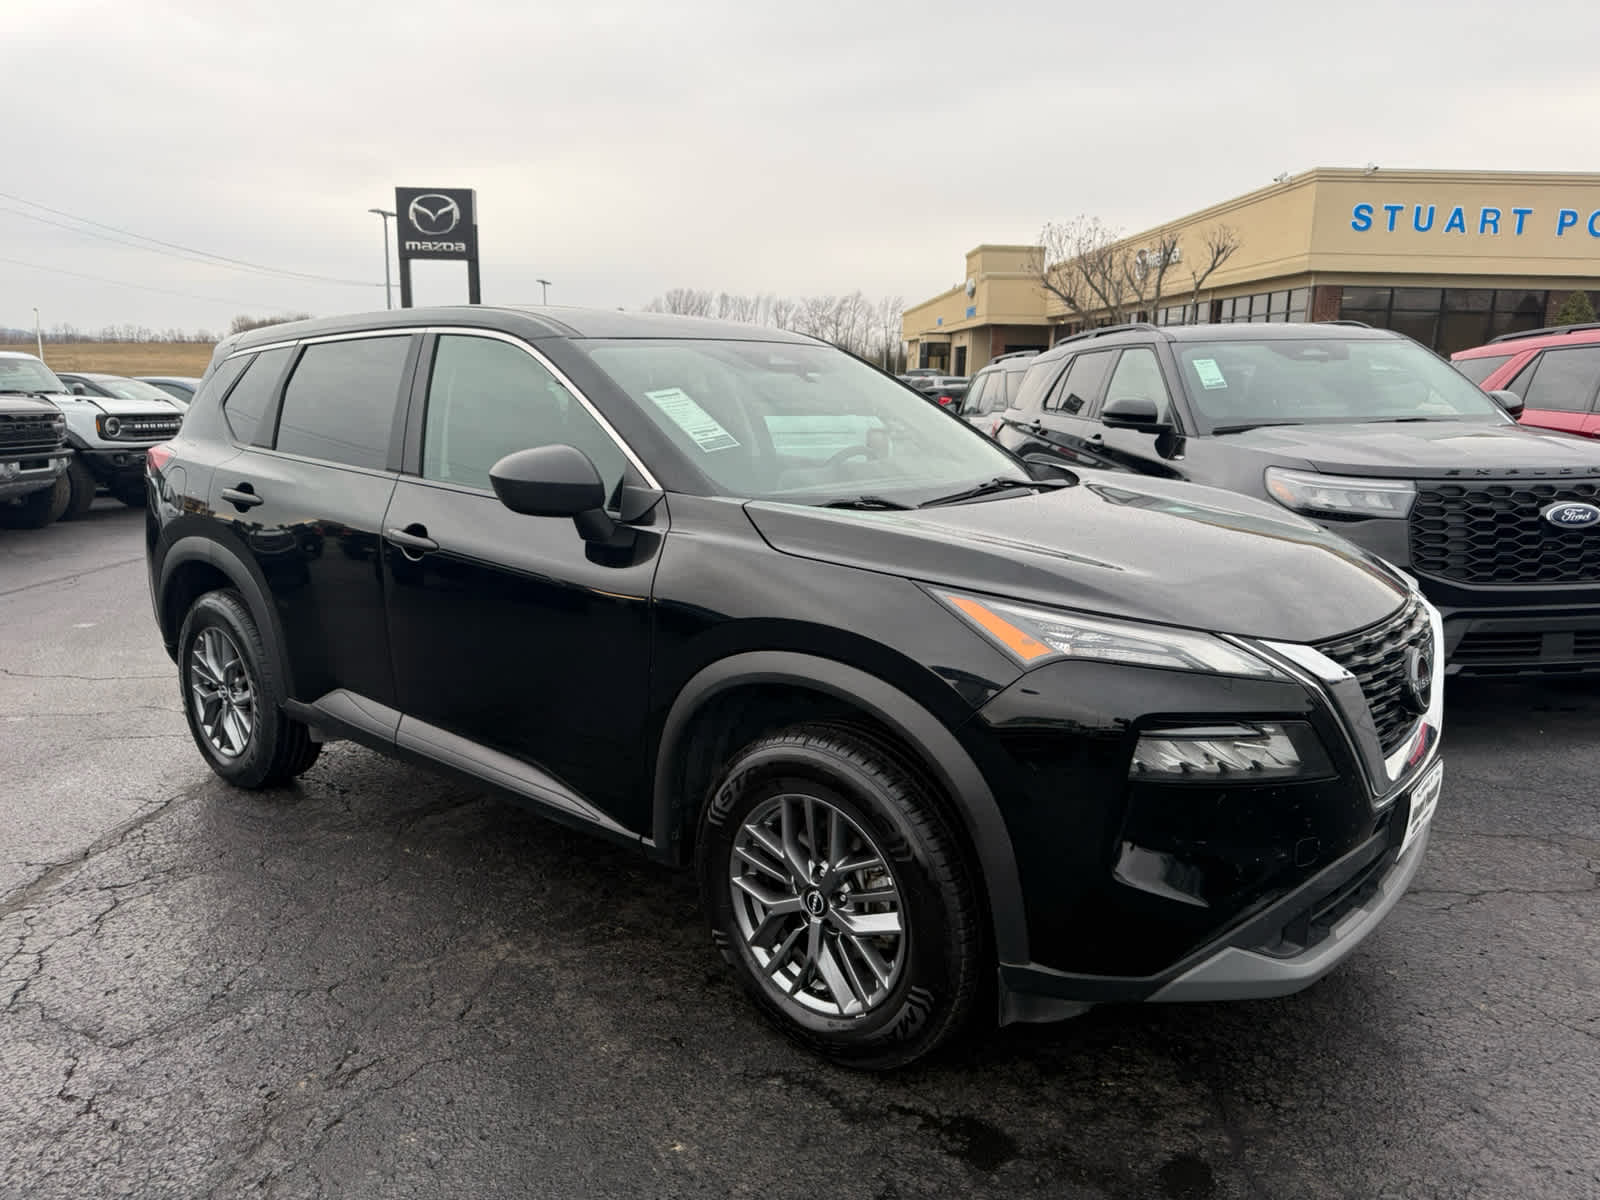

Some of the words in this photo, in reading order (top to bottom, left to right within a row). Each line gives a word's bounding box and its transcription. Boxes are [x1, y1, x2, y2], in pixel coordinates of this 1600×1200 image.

[1351, 203, 1534, 237] STUART
[405, 241, 466, 251] mazda
[1561, 508, 1592, 522] Ford
